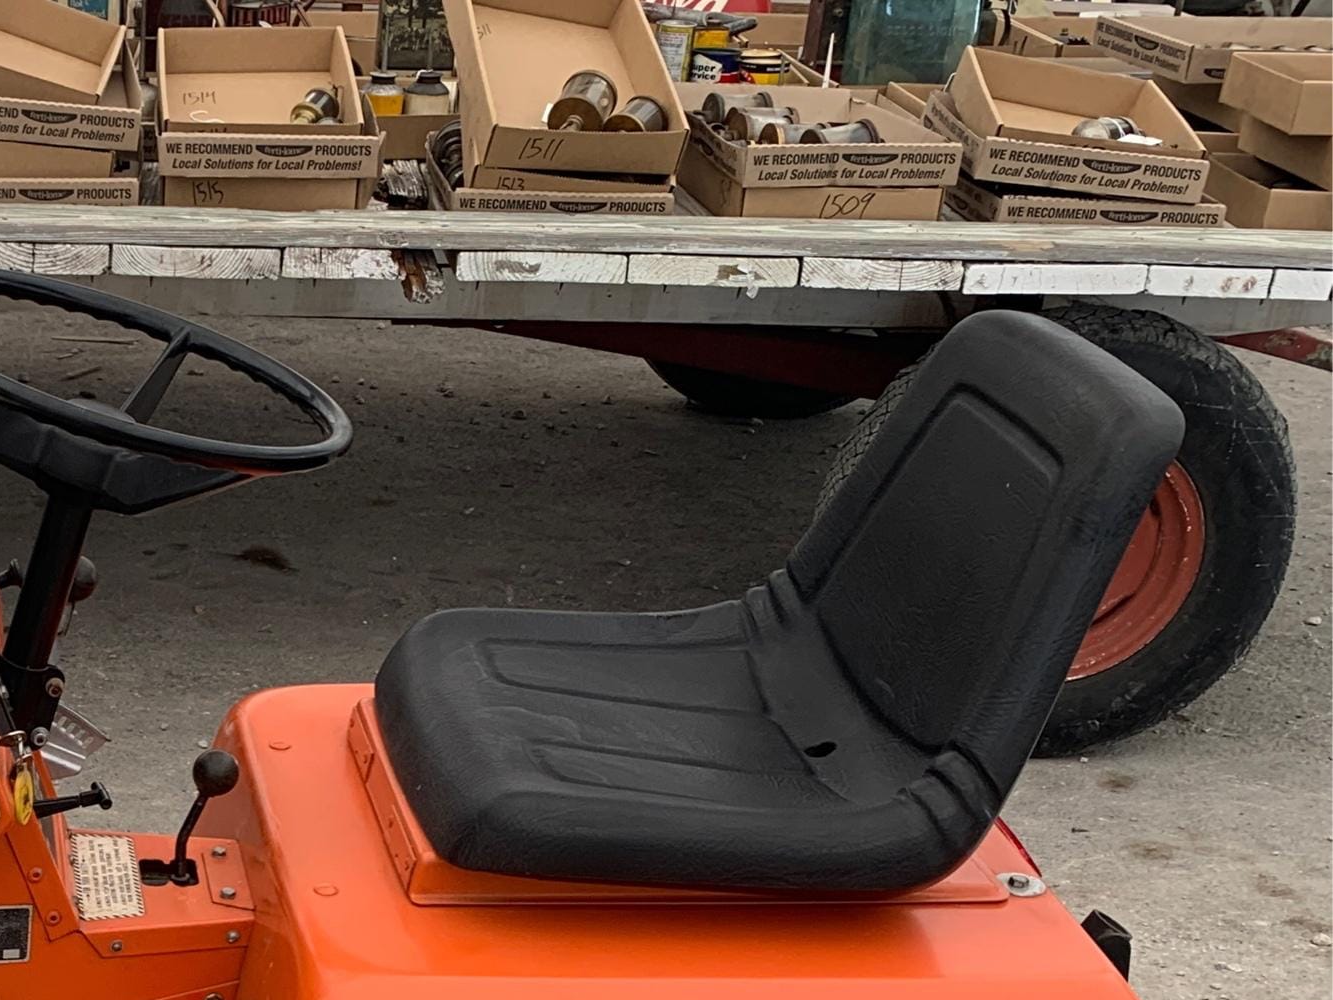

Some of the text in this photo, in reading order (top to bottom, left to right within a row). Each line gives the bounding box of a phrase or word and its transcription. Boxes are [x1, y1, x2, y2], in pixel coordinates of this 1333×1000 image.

[693, 63, 716, 72] uper
[182, 91, 216, 105] 1514
[79, 114, 135, 128] PRODUCTS
[22, 123, 37, 135] for
[39, 125, 68, 138] Local
[71, 128, 126, 142] Problems!
[166, 143, 182, 154] WE
[185, 143, 253, 155] RECOMMEND
[315, 144, 372, 156] PRODUCTS
[518, 137, 564, 161] 1511
[172, 158, 362, 171] Local Solutions for Local Problems!
[753, 155, 769, 166] WE
[772, 153, 839, 165] RECOMMEND
[900, 153, 956, 165] PRODUCTS
[989, 148, 1006, 160] WE
[1008, 149, 1080, 168] RECOMMEND
[1143, 164, 1202, 181] PRODUCTS
[757, 168, 945, 181] Local Solutions for Local Problems!
[991, 164, 1189, 195] Local Solutions for Local Problems!
[76, 188, 132, 200] PRODUCTS
[192, 180, 224, 205] 1515
[459, 198, 476, 209] WE
[478, 198, 547, 210] RECOMMEND
[609, 202, 666, 213] PRODUCTS
[819, 192, 876, 219] 1509
[1007, 206, 1024, 217] WE
[1026, 207, 1097, 220] RECOMMEND
[1160, 212, 1218, 224] PRODUCTS
